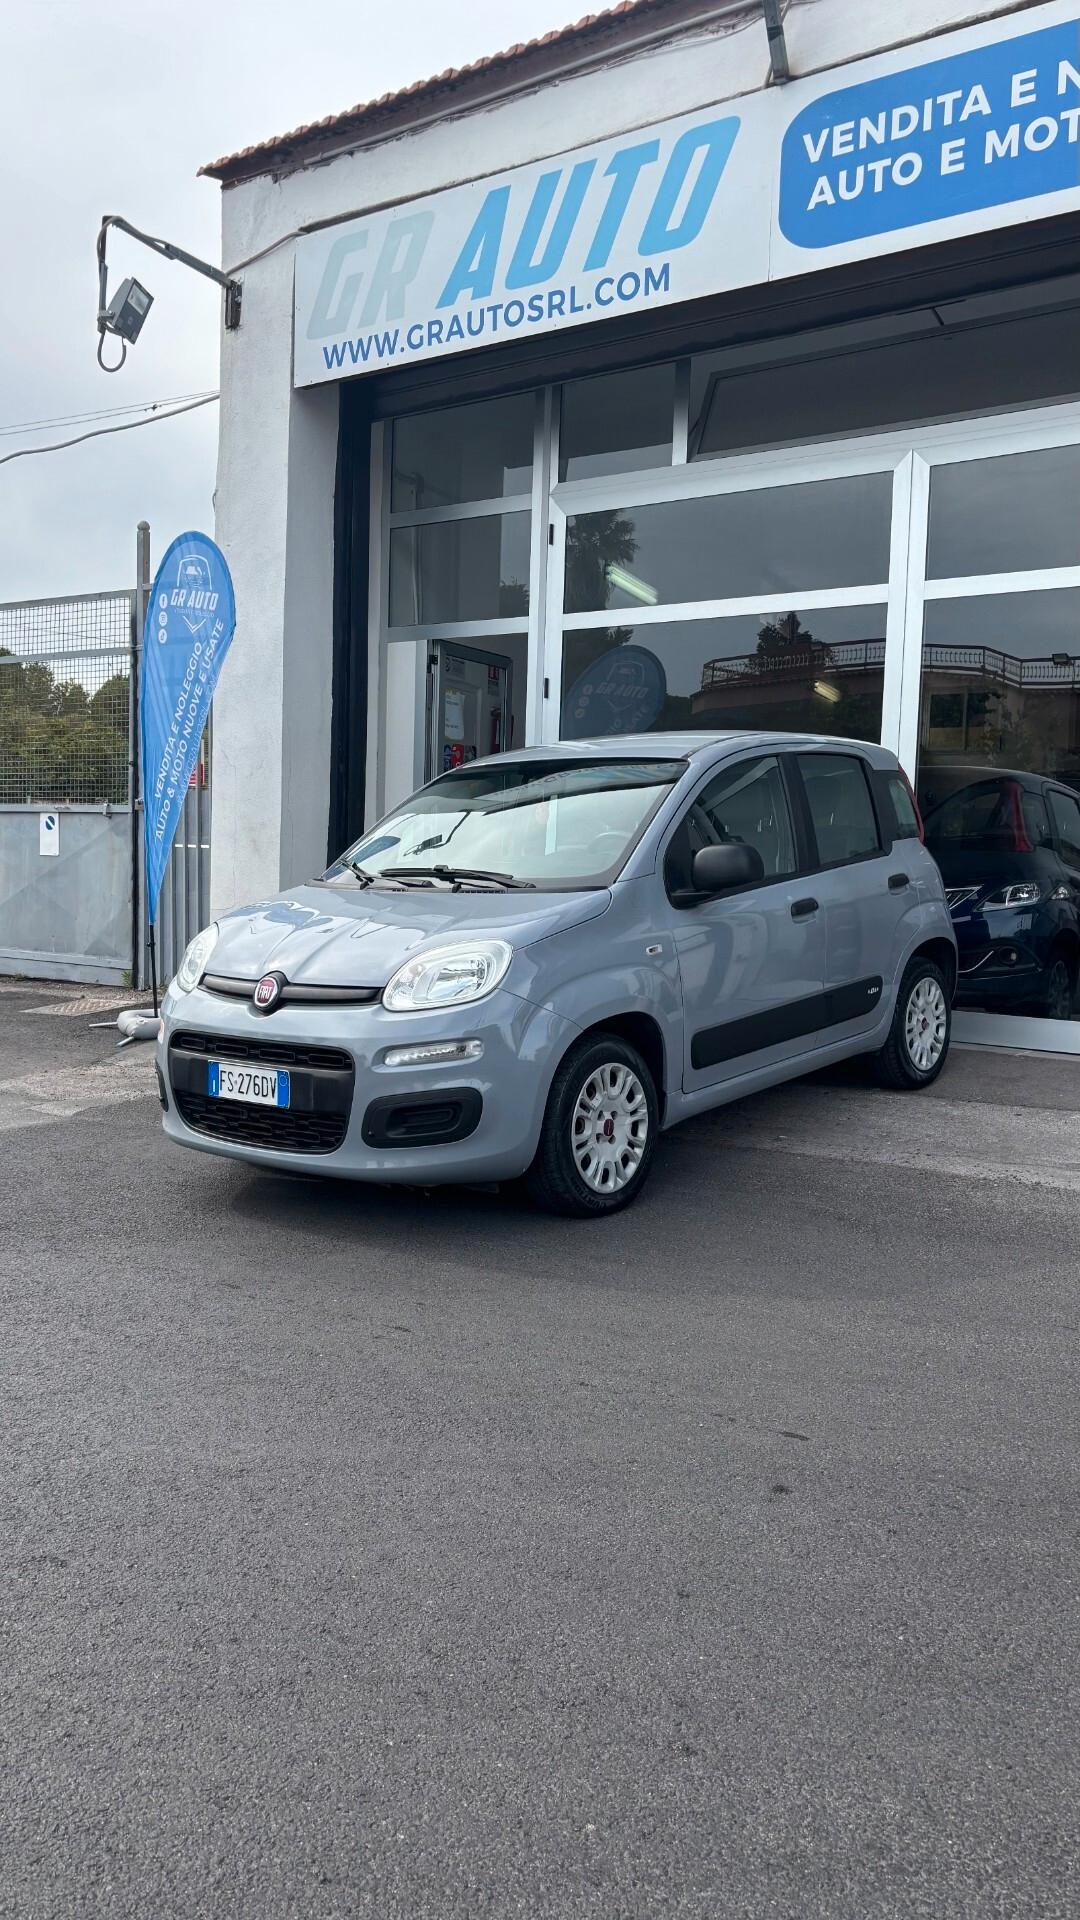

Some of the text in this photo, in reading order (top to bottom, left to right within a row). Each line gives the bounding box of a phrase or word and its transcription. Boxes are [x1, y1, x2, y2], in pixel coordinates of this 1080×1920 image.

[802, 84, 992, 163] VENDITA
[1010, 68, 1038, 108] E
[806, 152, 923, 211] AUTO
[940, 138, 966, 176] E
[306, 115, 741, 340] GR AUTO
[322, 263, 671, 370] WWW.GRAUTOSRL.COM
[171, 589, 219, 611] GR AUTO
[174, 642, 201, 722] NOLEGGIO
[155, 618, 223, 842] AUTO & MOTO NUOVE E USATE
[170, 722, 180, 734] E
[155, 737, 176, 800] VENDITA
[258, 985, 273, 999] FIAT
